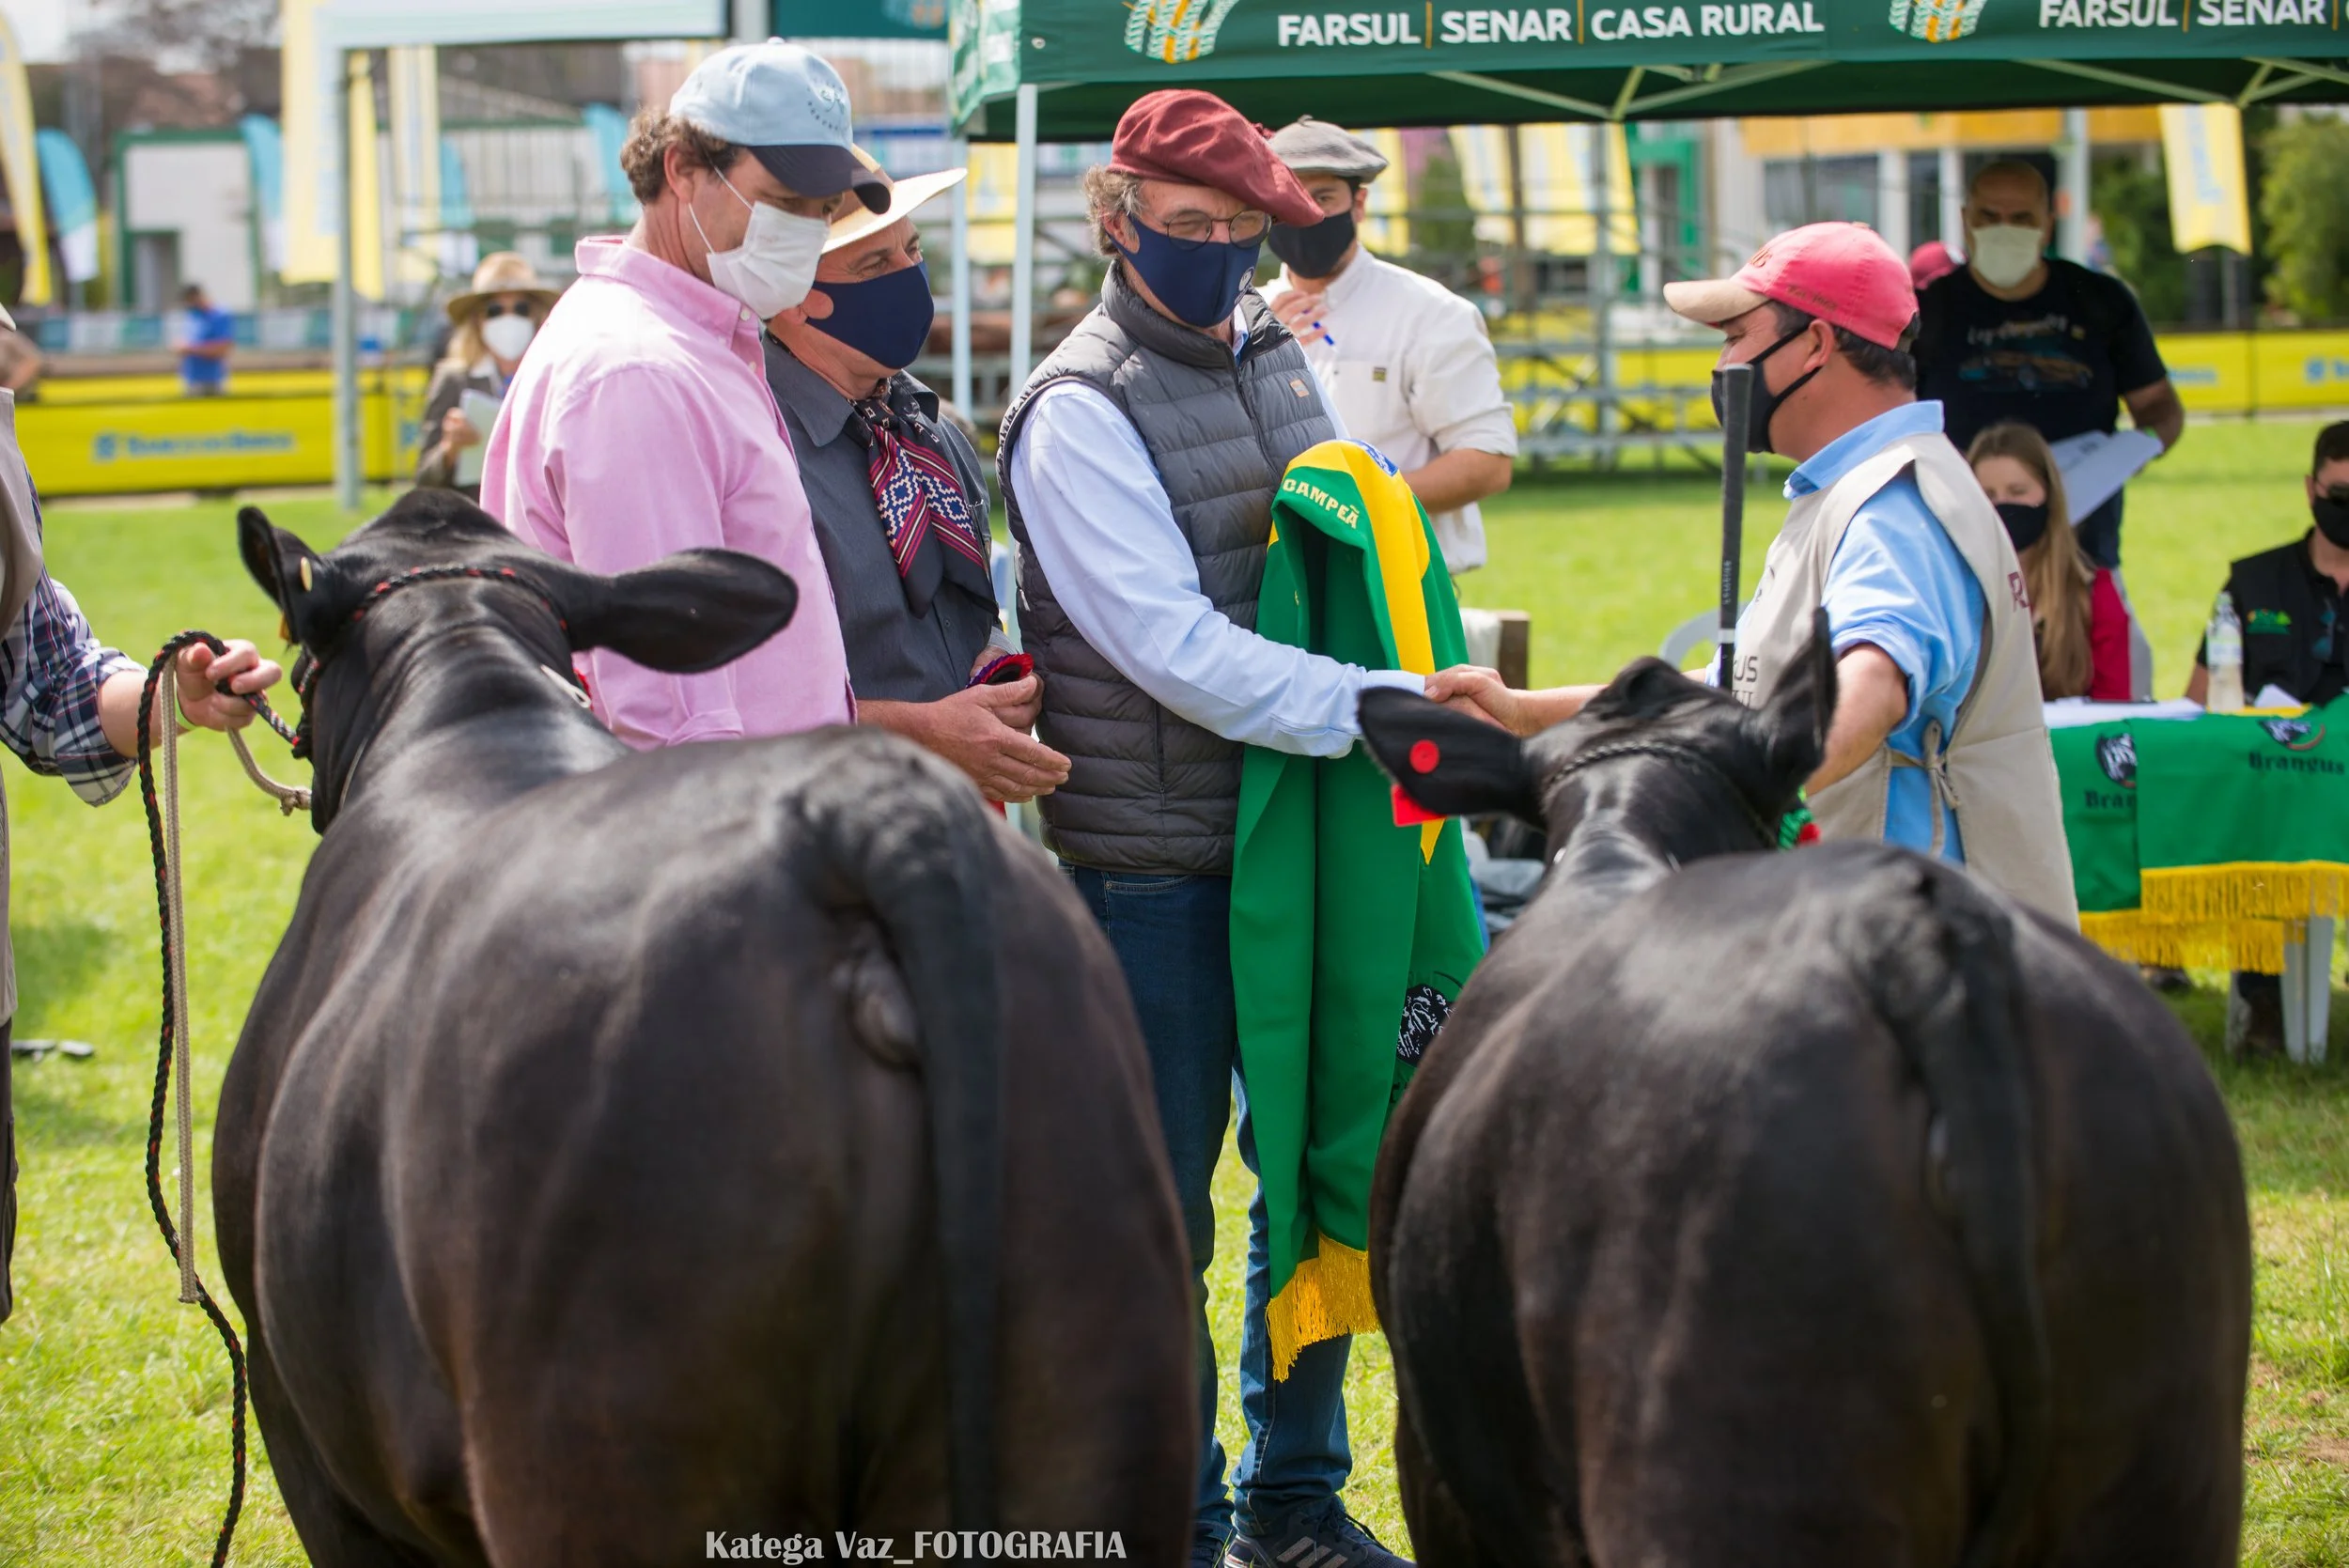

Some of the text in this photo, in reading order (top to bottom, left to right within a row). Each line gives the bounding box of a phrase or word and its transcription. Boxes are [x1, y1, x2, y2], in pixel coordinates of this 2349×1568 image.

[1278, 2, 1826, 47] FARSUL SENAR CASA RURAL
[2039, 0, 2178, 28] FARSUL
[2197, 0, 2326, 26] SENAR
[1283, 478, 1361, 529] CAMPEÃ
[2248, 751, 2346, 775] Brangus
